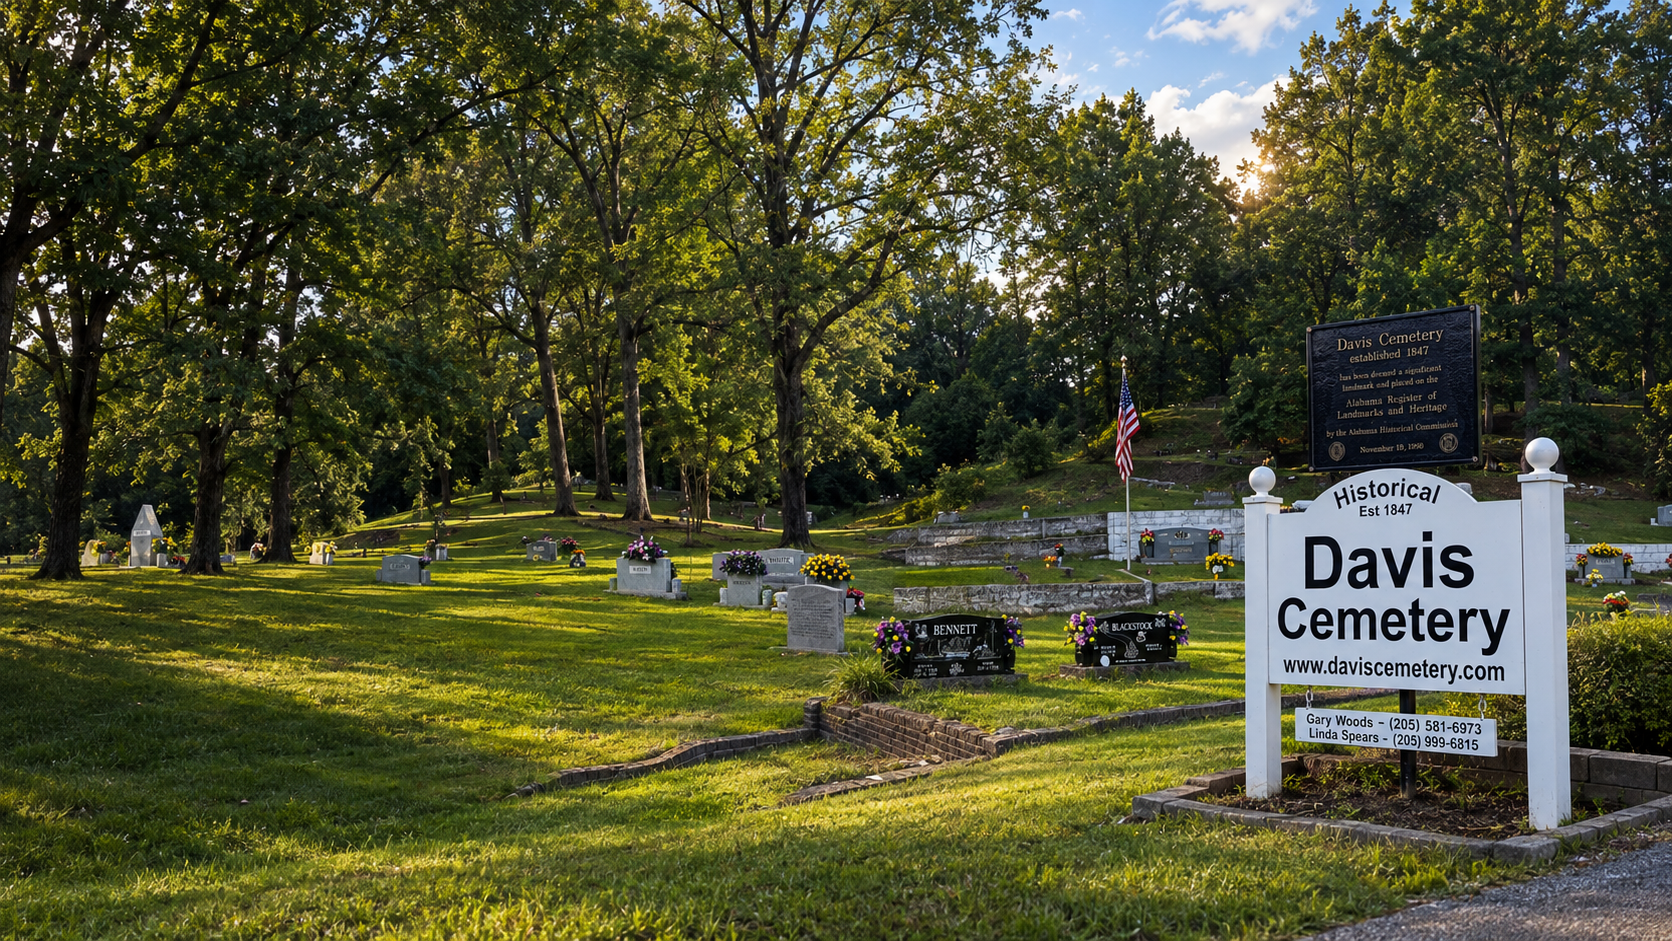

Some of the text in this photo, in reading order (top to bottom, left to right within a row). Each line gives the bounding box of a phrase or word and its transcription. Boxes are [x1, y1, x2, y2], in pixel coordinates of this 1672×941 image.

[1337, 329, 1444, 351] Davis Cemetery
[1349, 346, 1429, 363] established 1847
[1376, 380, 1390, 388] and
[1391, 377, 1413, 389] placed
[1426, 375, 1438, 384] the
[1346, 390, 1438, 408] Alabama Register of
[1337, 403, 1448, 420] Landmarks and Heritage
[1326, 430, 1335, 439] by
[1336, 429, 1347, 437] the
[1380, 424, 1414, 434] Historical
[1359, 444, 1394, 453] November
[1333, 478, 1441, 510] Historical
[1359, 503, 1413, 517] Est 1847
[1304, 531, 1475, 590] Davis
[933, 623, 978, 636] BENNETT
[1111, 622, 1153, 632] BLACKSTOCK
[1277, 597, 1511, 656] Cemetery
[1283, 656, 1505, 685] www.daviscemetery.com
[1306, 713, 1332, 727] Gary
[1336, 715, 1374, 728] Woods
[1389, 717, 1421, 733] (205)
[1425, 719, 1482, 735] 581-6973
[1309, 727, 1338, 740] Linda
[1341, 729, 1379, 744] Spears
[1392, 732, 1421, 748] (205)
[1424, 735, 1479, 751] 999-6815
